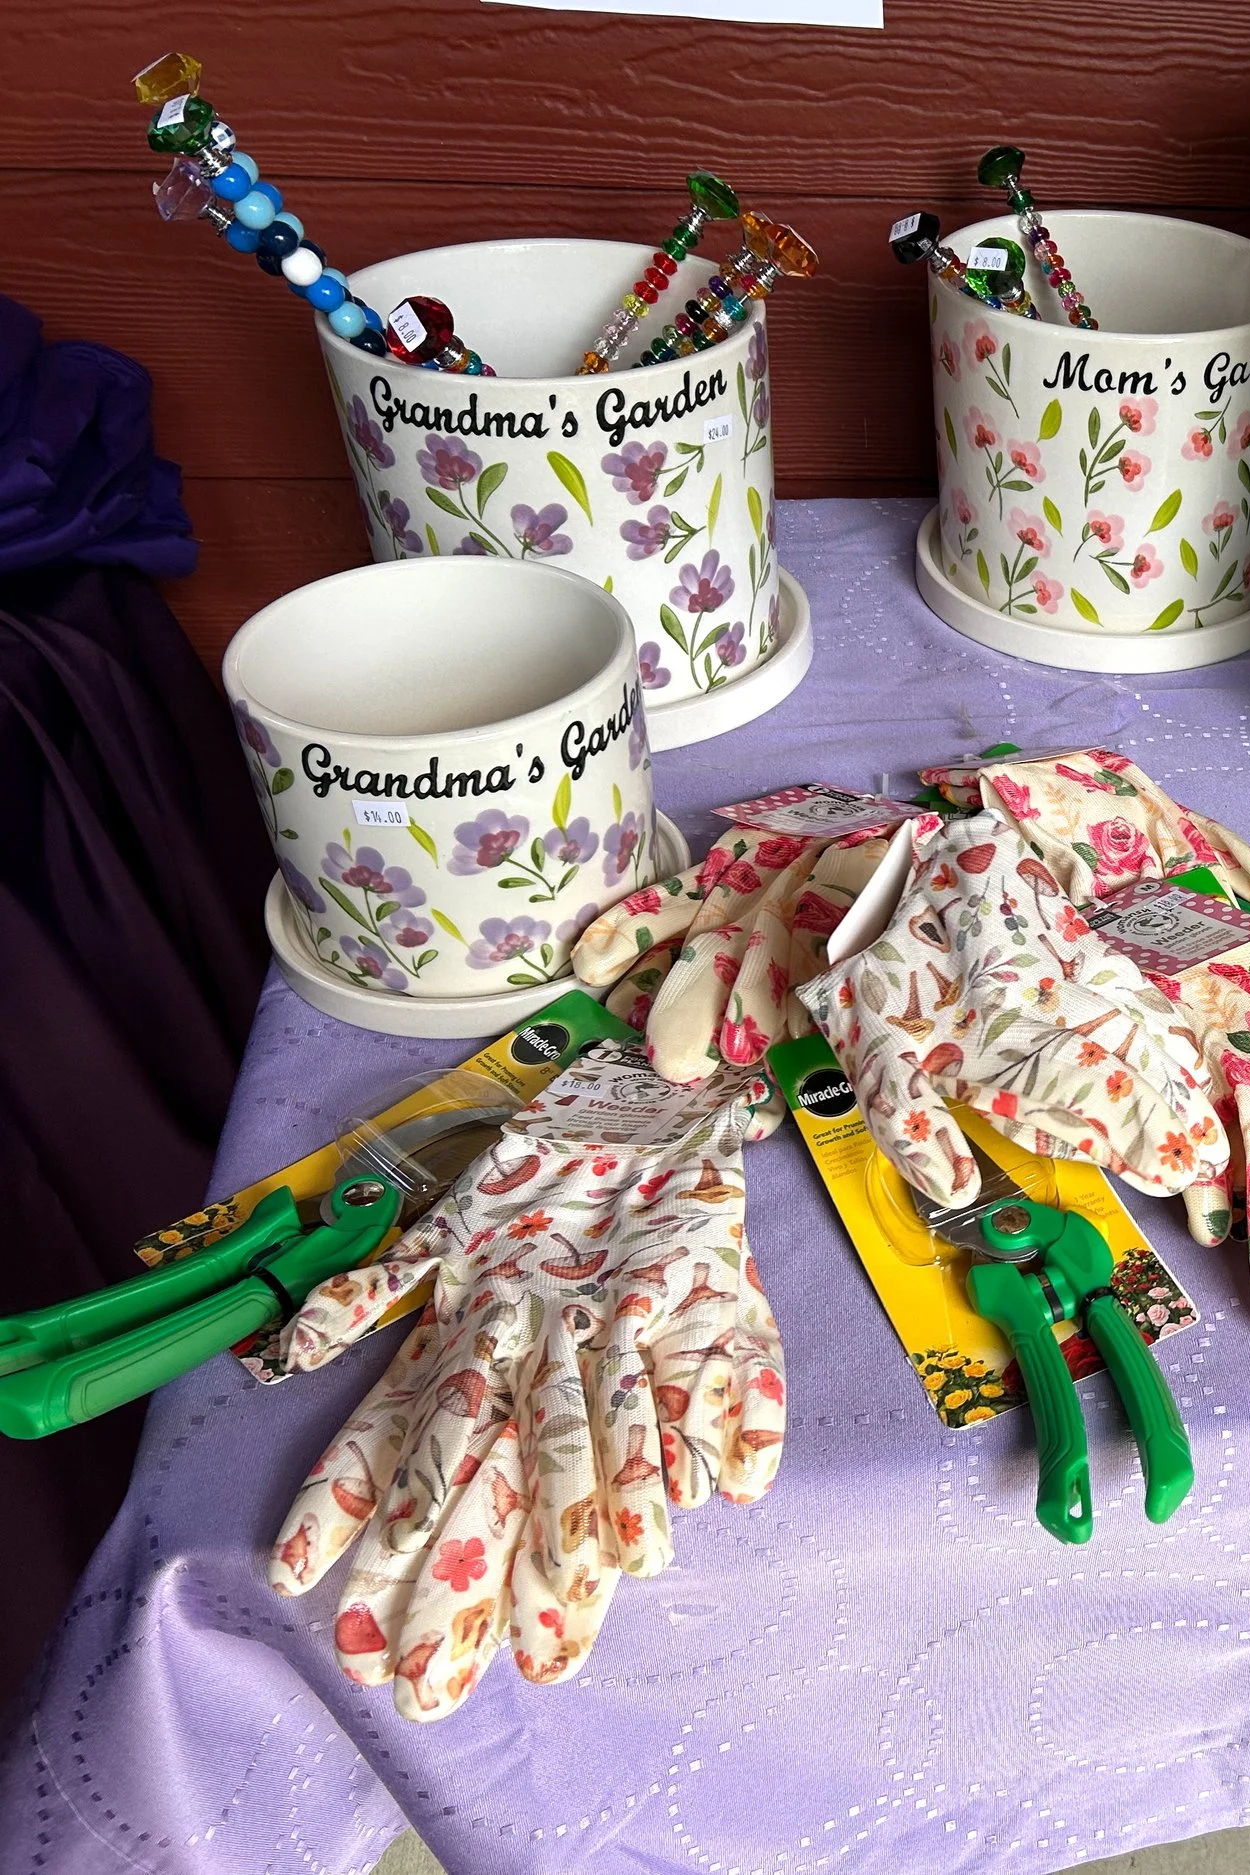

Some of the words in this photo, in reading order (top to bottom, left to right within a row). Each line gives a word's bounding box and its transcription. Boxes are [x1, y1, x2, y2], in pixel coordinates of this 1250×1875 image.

[1043, 351, 1187, 396] Mom's
[369, 375, 578, 439] Grandma's
[596, 368, 727, 447] Garden
[708, 424, 729, 440] $24.00
[301, 743, 545, 800] Grandma's
[363, 810, 402, 824] $14.00
[1140, 884, 1155, 892] M
[1151, 920, 1206, 946] Weeder
[562, 1080, 601, 1091] $18.00
[798, 1081, 854, 1107] Miracle-Gr
[588, 1100, 668, 1114] Weeder
[813, 1130, 832, 1140] Great
[832, 1126, 843, 1134] for
[844, 1120, 866, 1130] Prunin
[816, 1135, 842, 1147] Growth
[843, 1131, 855, 1139] and
[855, 1126, 868, 1135] Sof
